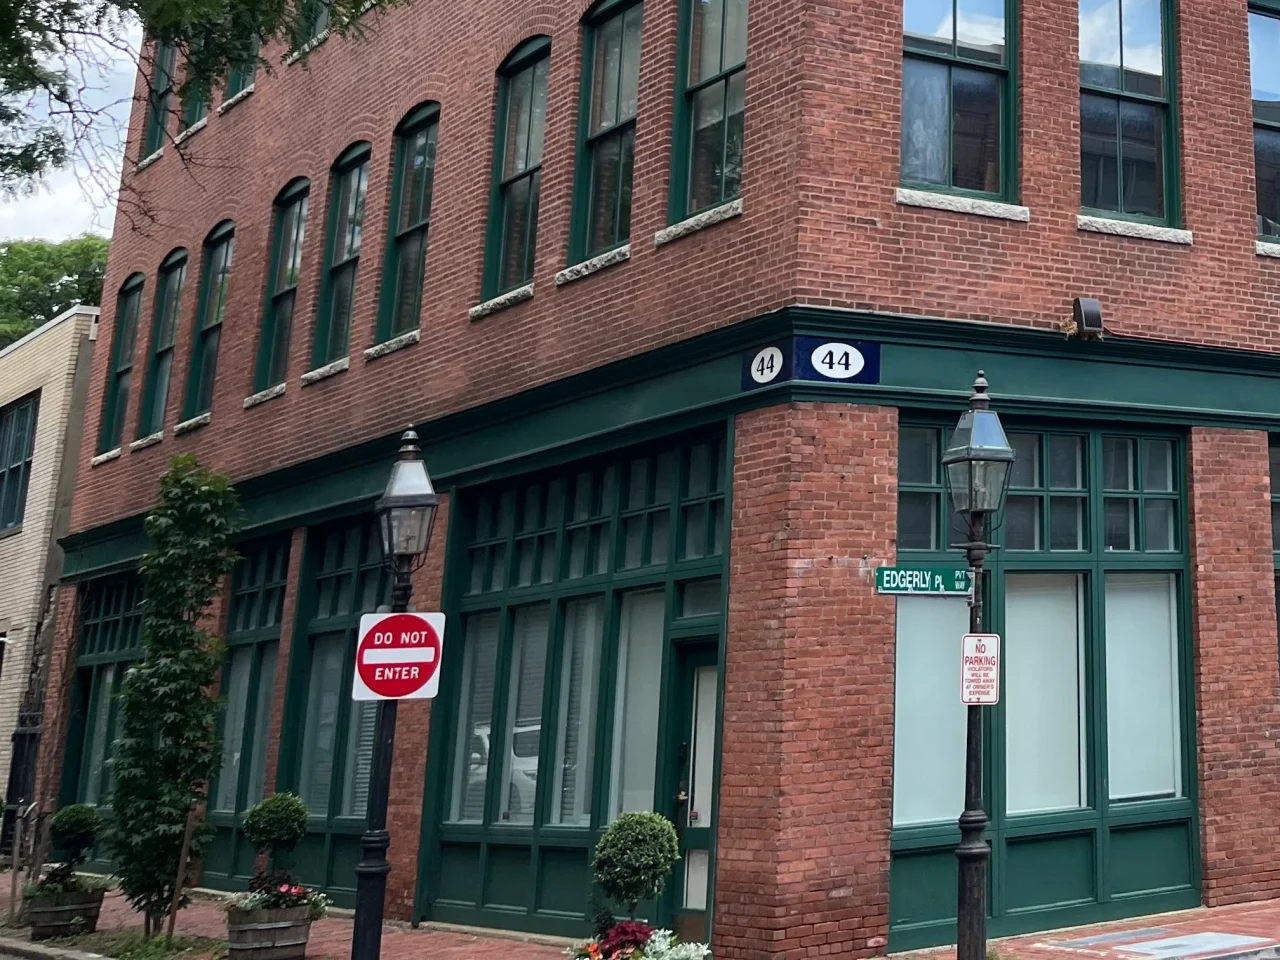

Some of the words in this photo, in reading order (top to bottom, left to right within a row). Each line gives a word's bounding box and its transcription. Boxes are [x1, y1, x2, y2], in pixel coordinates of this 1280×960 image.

[756, 354, 774, 376] 44
[821, 350, 851, 370] 44
[883, 570, 931, 588] EDGERLY
[934, 575, 945, 588] PL
[955, 570, 966, 579] PVT
[955, 581, 966, 590] WAY
[374, 632, 393, 645] DO
[400, 631, 428, 644] NOT
[976, 644, 986, 654] NO
[965, 656, 996, 666] PARKING
[375, 667, 419, 680] ENTER
